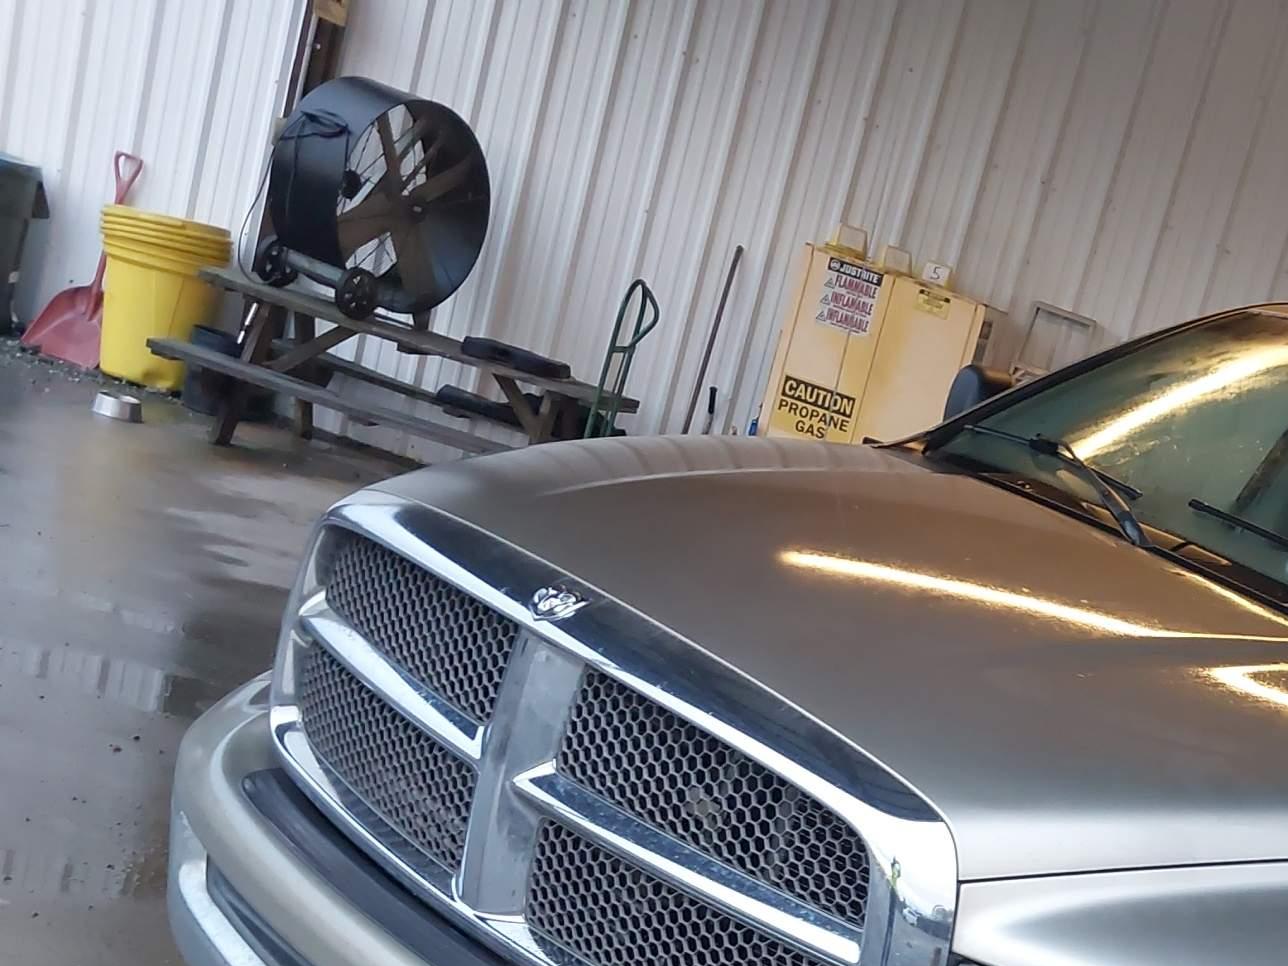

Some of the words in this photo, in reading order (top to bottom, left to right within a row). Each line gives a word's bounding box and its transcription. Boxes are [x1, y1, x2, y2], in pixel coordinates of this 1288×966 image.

[835, 275, 878, 299] FLAMMABLE
[784, 379, 853, 416] CAUTION
[778, 399, 849, 433] PROPANE
[795, 420, 825, 439] GAS
